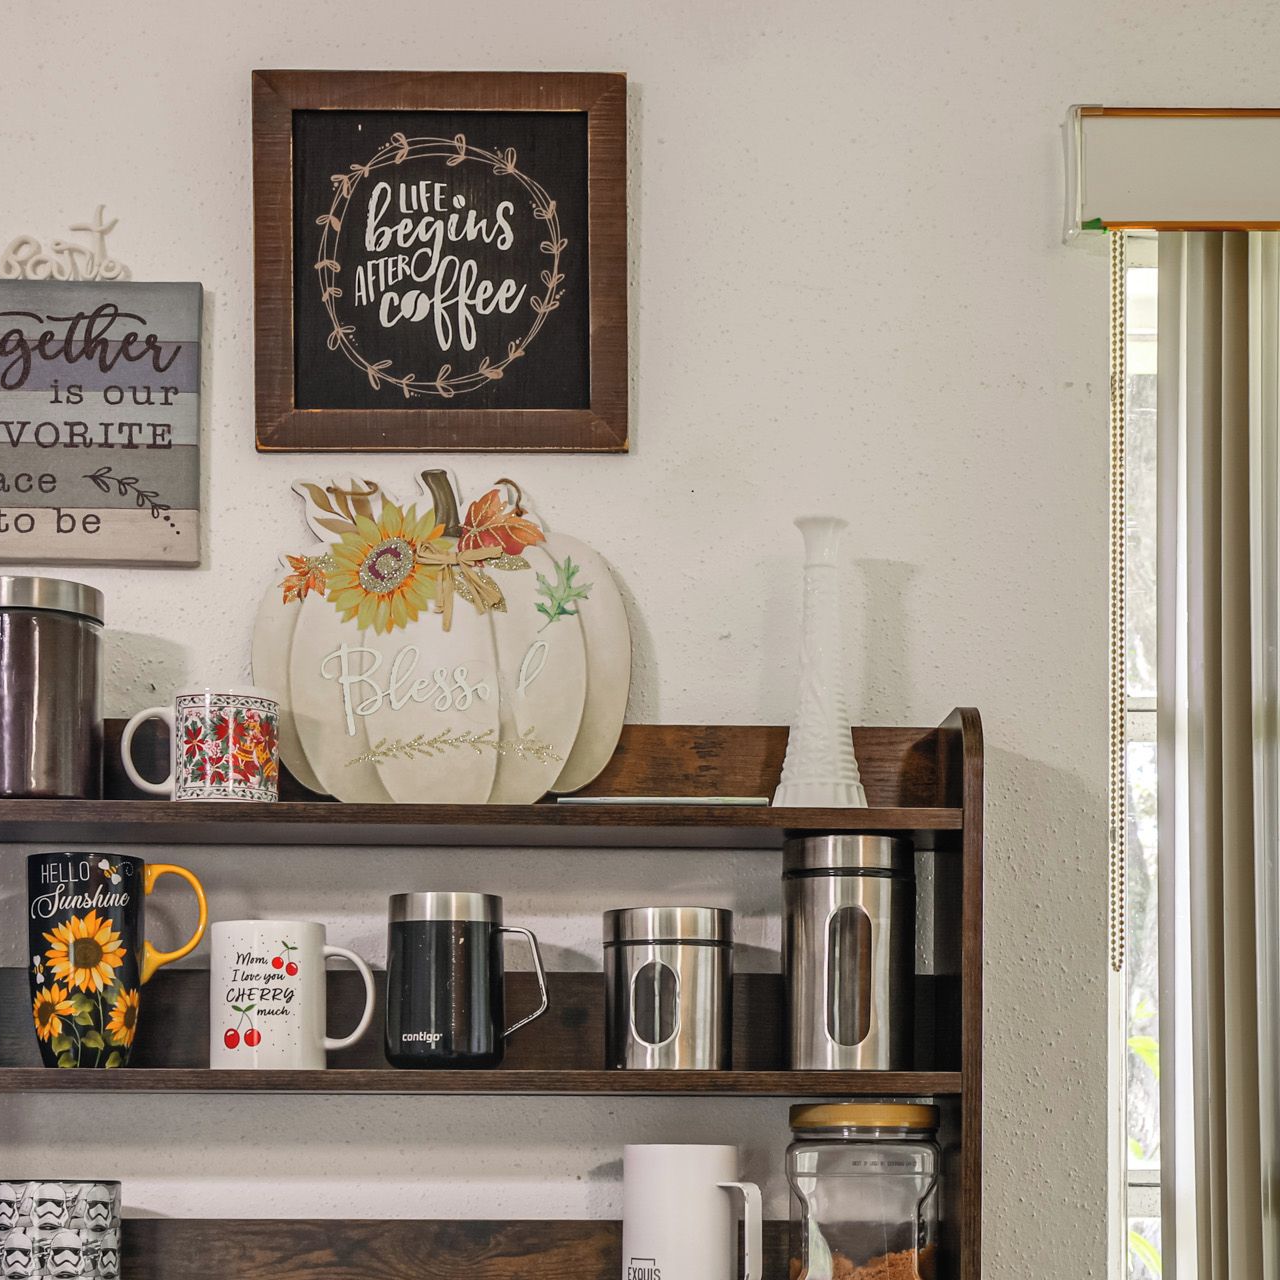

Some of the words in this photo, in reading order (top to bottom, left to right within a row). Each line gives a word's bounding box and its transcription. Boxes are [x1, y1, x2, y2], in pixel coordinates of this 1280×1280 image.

[398, 180, 448, 213] LIFE
[364, 181, 515, 283] begins
[354, 254, 411, 307] AFTER
[378, 255, 528, 351] coffee
[49, 378, 84, 406] is
[103, 384, 180, 407] our
[55, 507, 102, 535] be
[41, 860, 90, 884] HELLO
[30, 883, 131, 919] Sunshine
[235, 951, 269, 967] Mom,
[232, 969, 240, 982] I
[240, 970, 261, 982] love
[263, 973, 286, 985] you
[225, 987, 295, 1004] CHERRY
[256, 1005, 291, 1017] much
[402, 1031, 441, 1044] contigo
